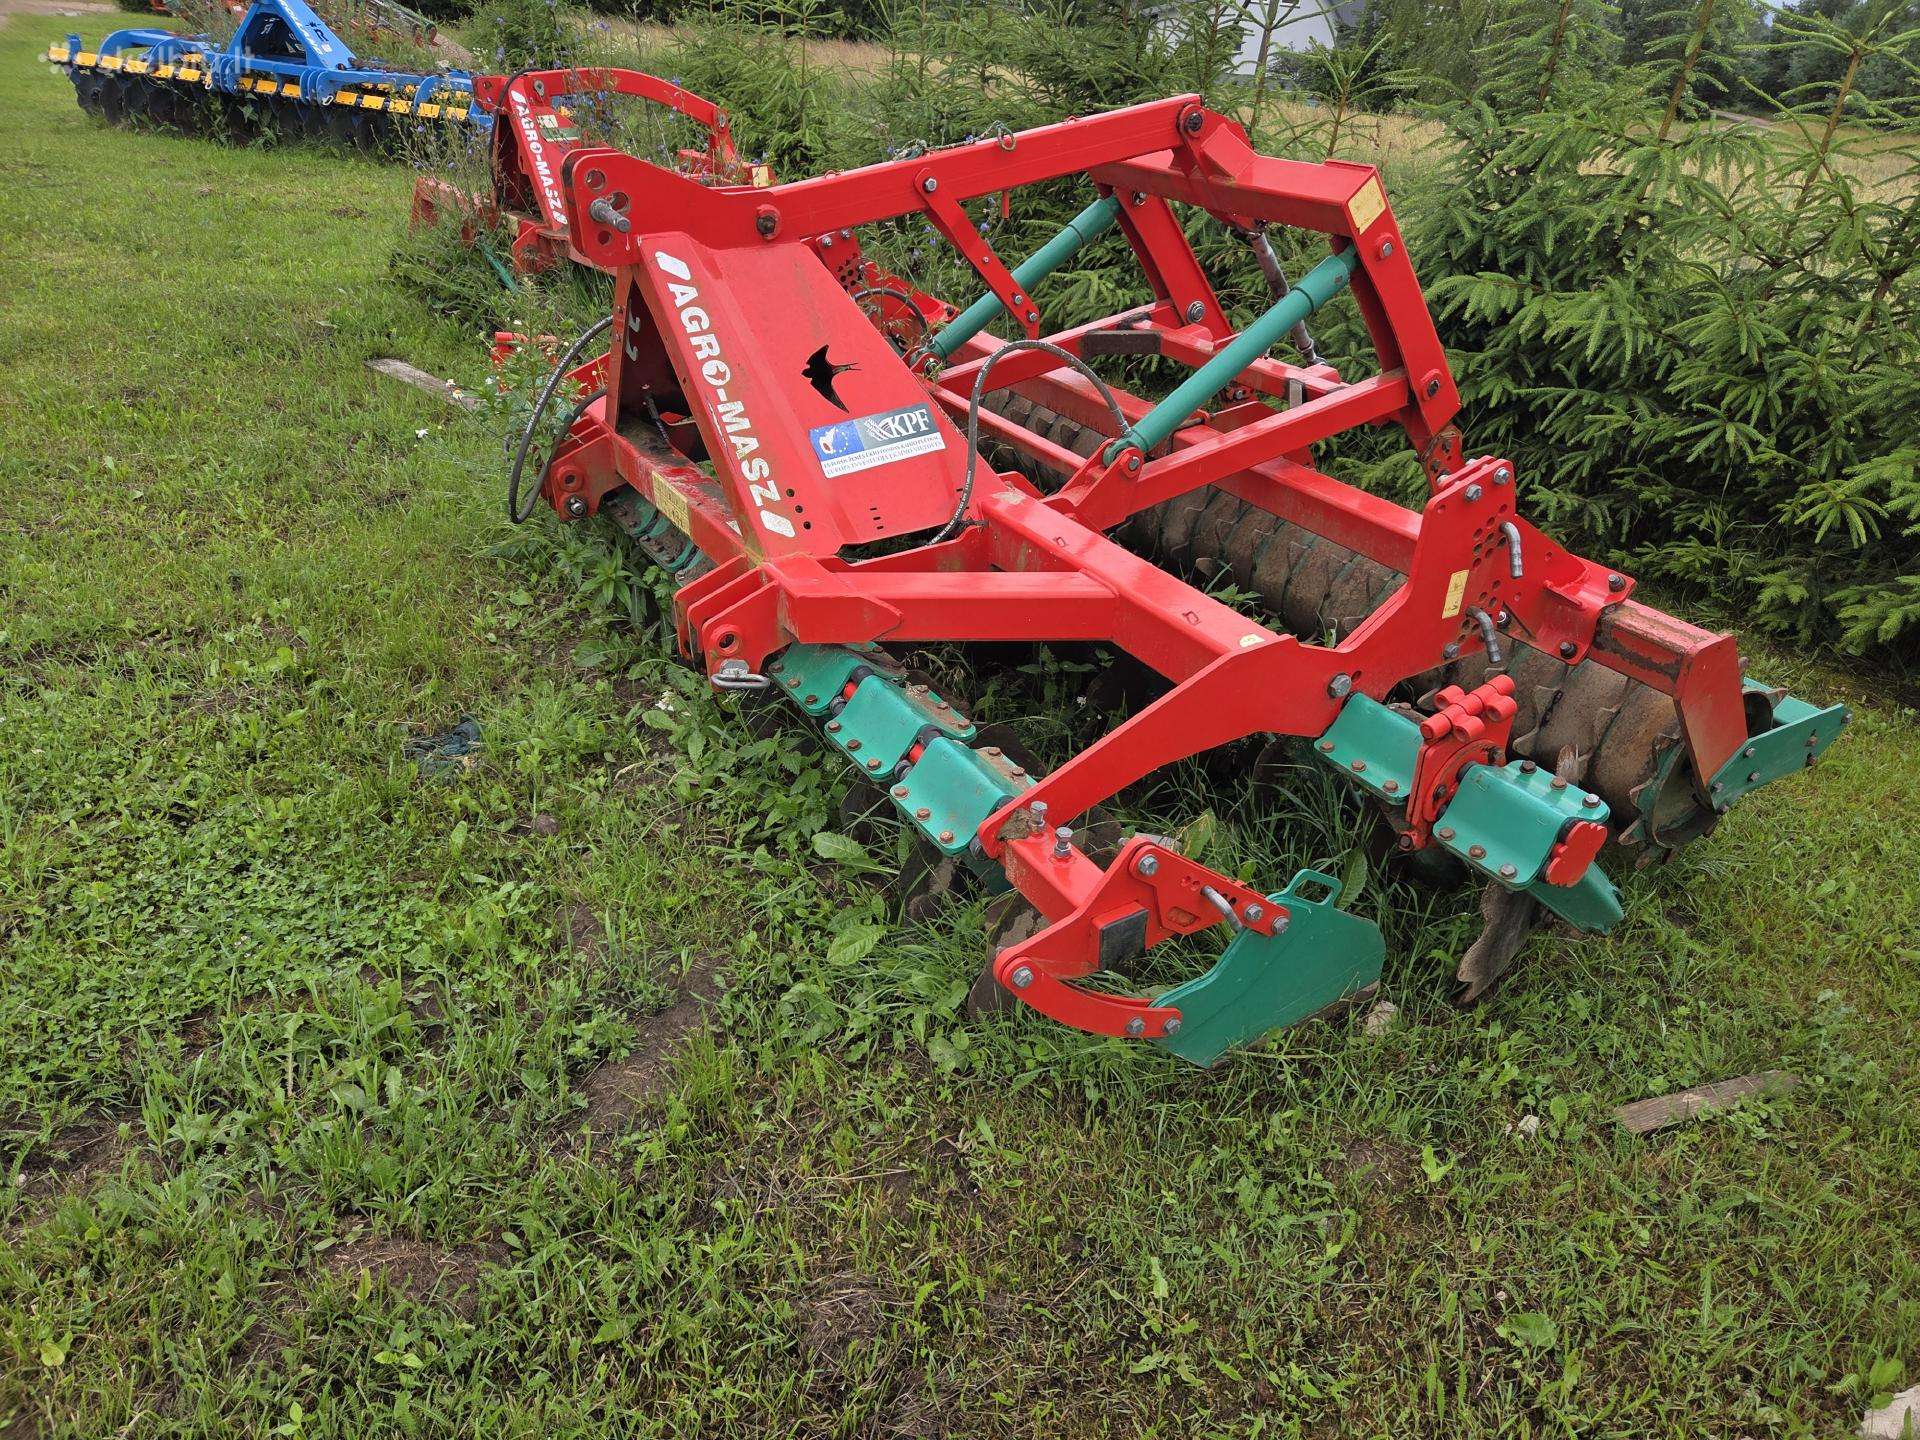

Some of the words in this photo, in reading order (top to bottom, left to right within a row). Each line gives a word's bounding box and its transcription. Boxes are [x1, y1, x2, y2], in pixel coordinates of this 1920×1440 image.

[516, 105, 562, 208] AGRO-MASZ
[667, 282, 781, 506] AGRO-MASZ
[887, 408, 930, 438] KPF
